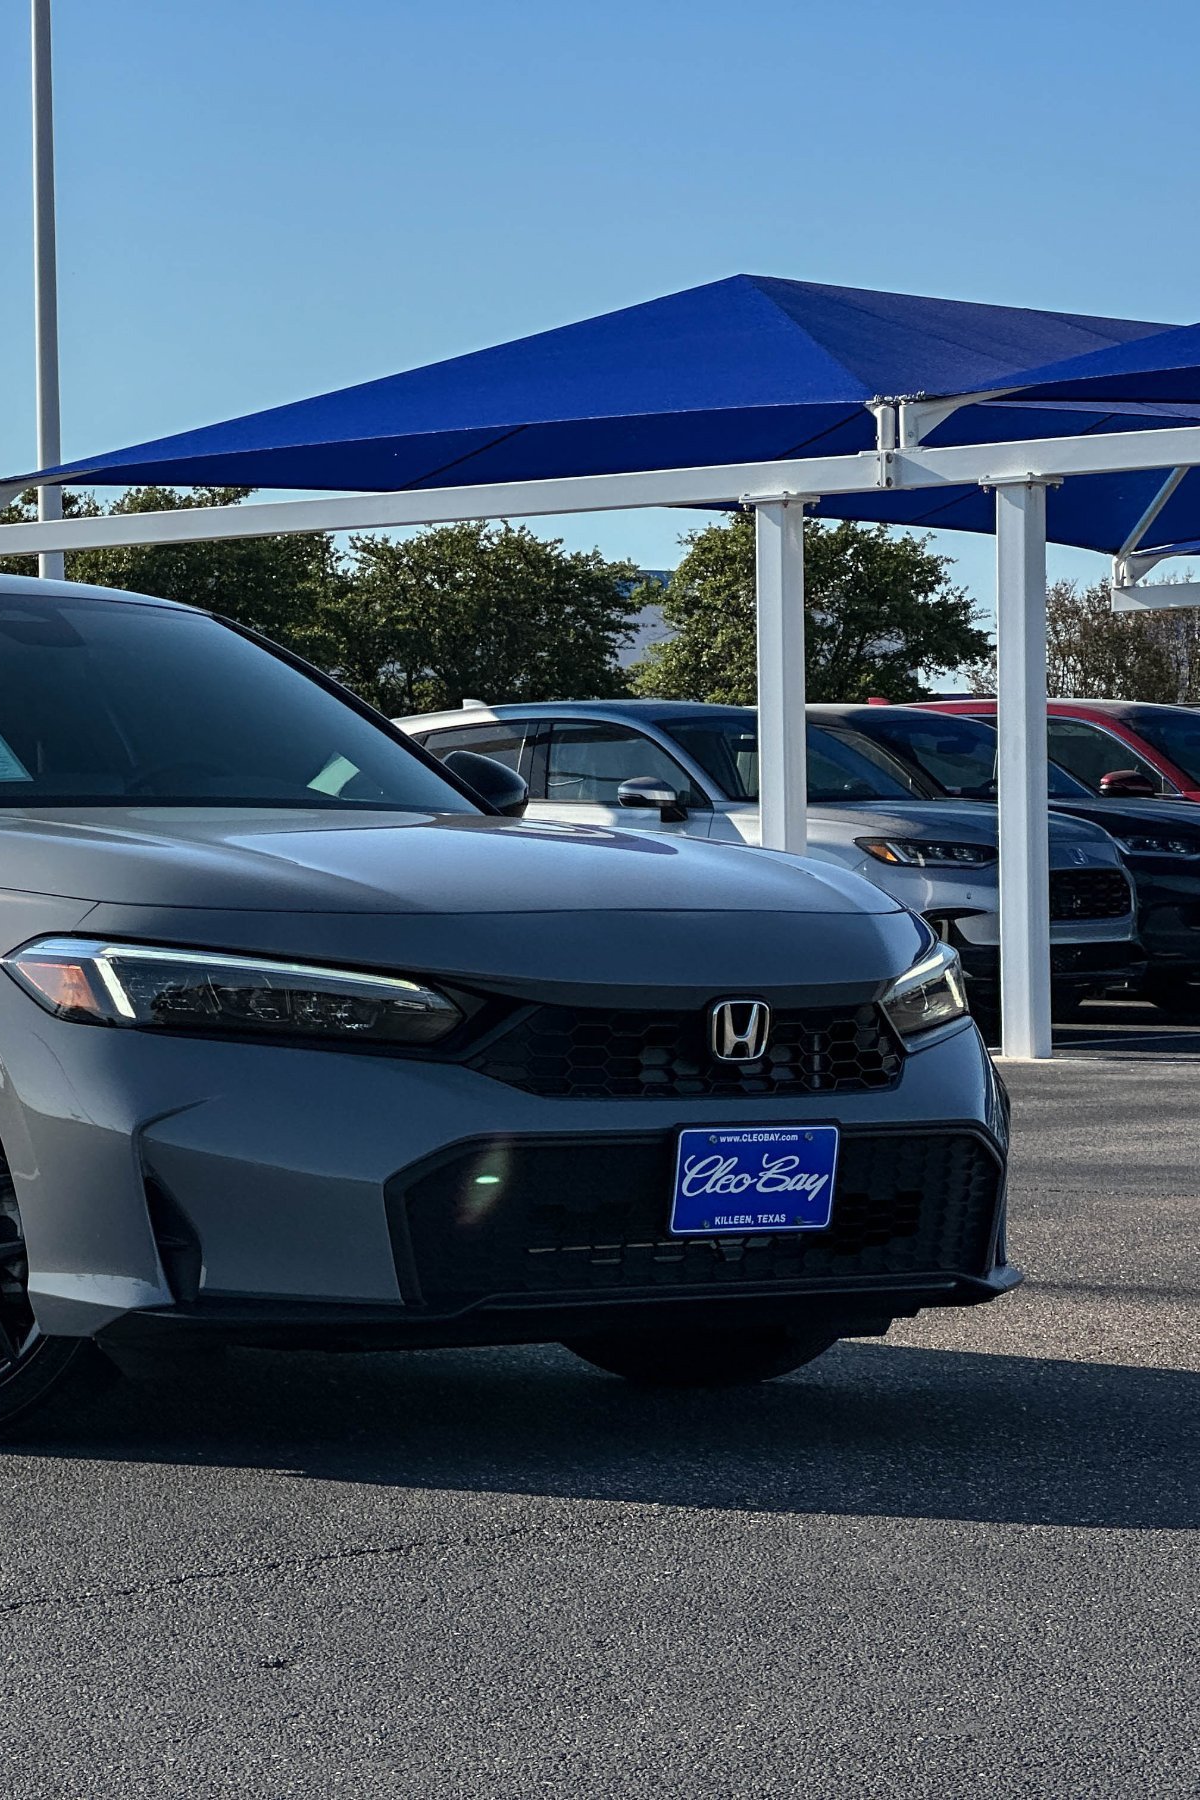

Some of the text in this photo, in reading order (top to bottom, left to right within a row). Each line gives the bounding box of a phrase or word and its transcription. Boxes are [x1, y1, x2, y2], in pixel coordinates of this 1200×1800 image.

[719, 1133, 799, 1143] www.CLEOBAY.com
[681, 1153, 829, 1202] Cleo Bay
[714, 1213, 787, 1226] KILLEEN, TEXAS
